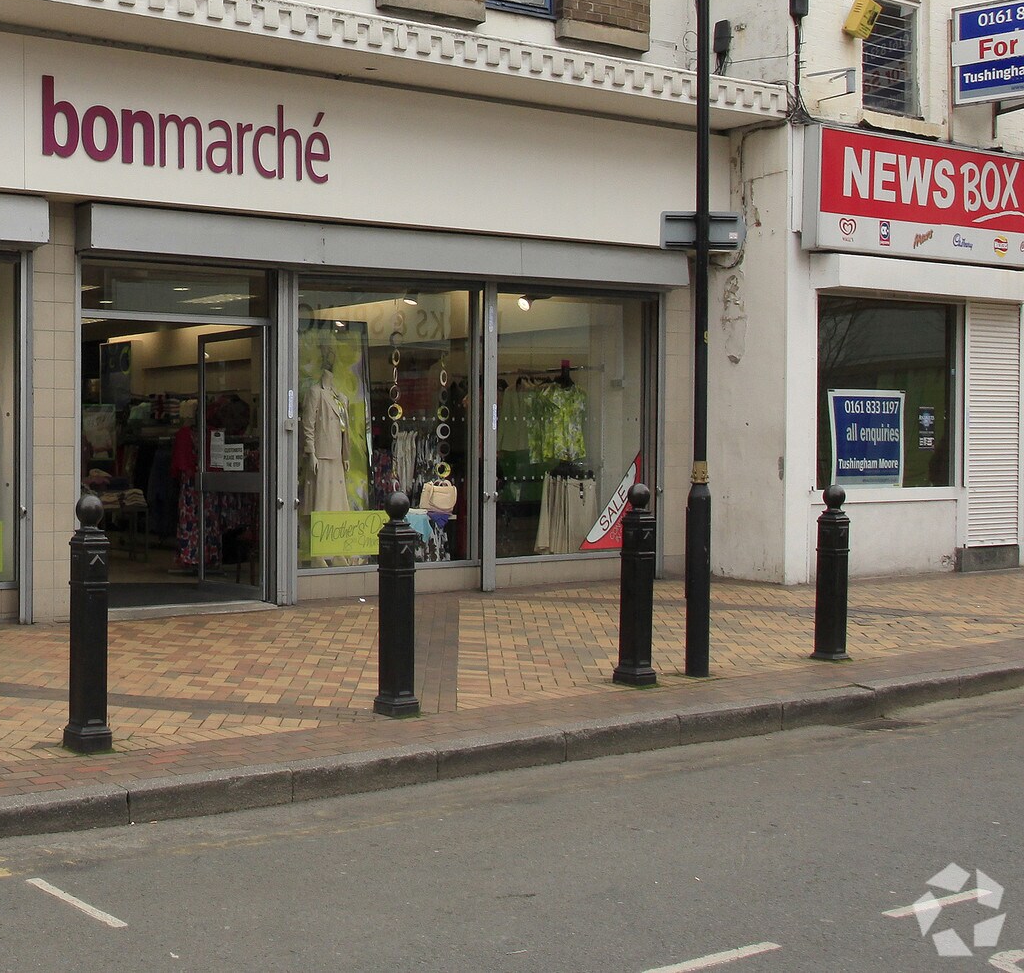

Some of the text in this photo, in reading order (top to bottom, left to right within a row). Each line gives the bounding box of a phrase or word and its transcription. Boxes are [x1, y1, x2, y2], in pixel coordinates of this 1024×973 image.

[978, 9, 1012, 27] 0161
[979, 38, 1018, 59] For
[963, 65, 1024, 84] Tushingha
[41, 75, 331, 184] bonmarché
[844, 400, 899, 414] 0161 833 1197
[846, 423, 858, 441] all
[860, 423, 900, 446] enquiries
[838, 457, 899, 472] Tushingham Moore
[599, 485, 630, 532] SALE
[311, 520, 366, 542] Mother's
